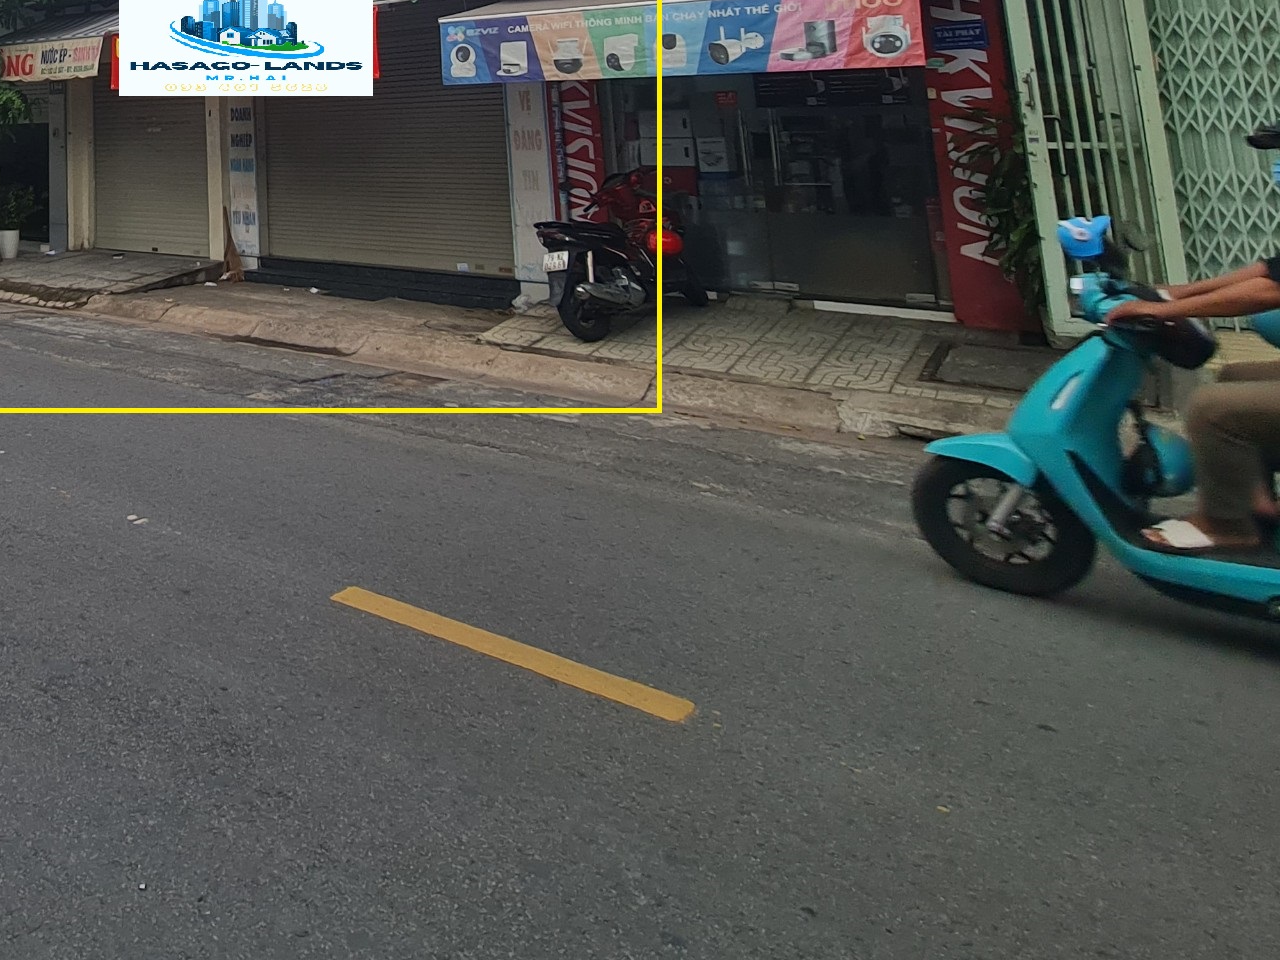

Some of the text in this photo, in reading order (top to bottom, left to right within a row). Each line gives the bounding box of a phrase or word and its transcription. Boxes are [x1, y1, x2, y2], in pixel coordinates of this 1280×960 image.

[507, 23, 549, 34] CAMERA
[550, 20, 571, 31] WIFI
[574, 16, 612, 28] THÔNG
[614, 14, 643, 25] MINH
[672, 9, 705, 22] CHẠY
[707, 4, 741, 18] NHẤT
[743, 3, 770, 16] THẾ
